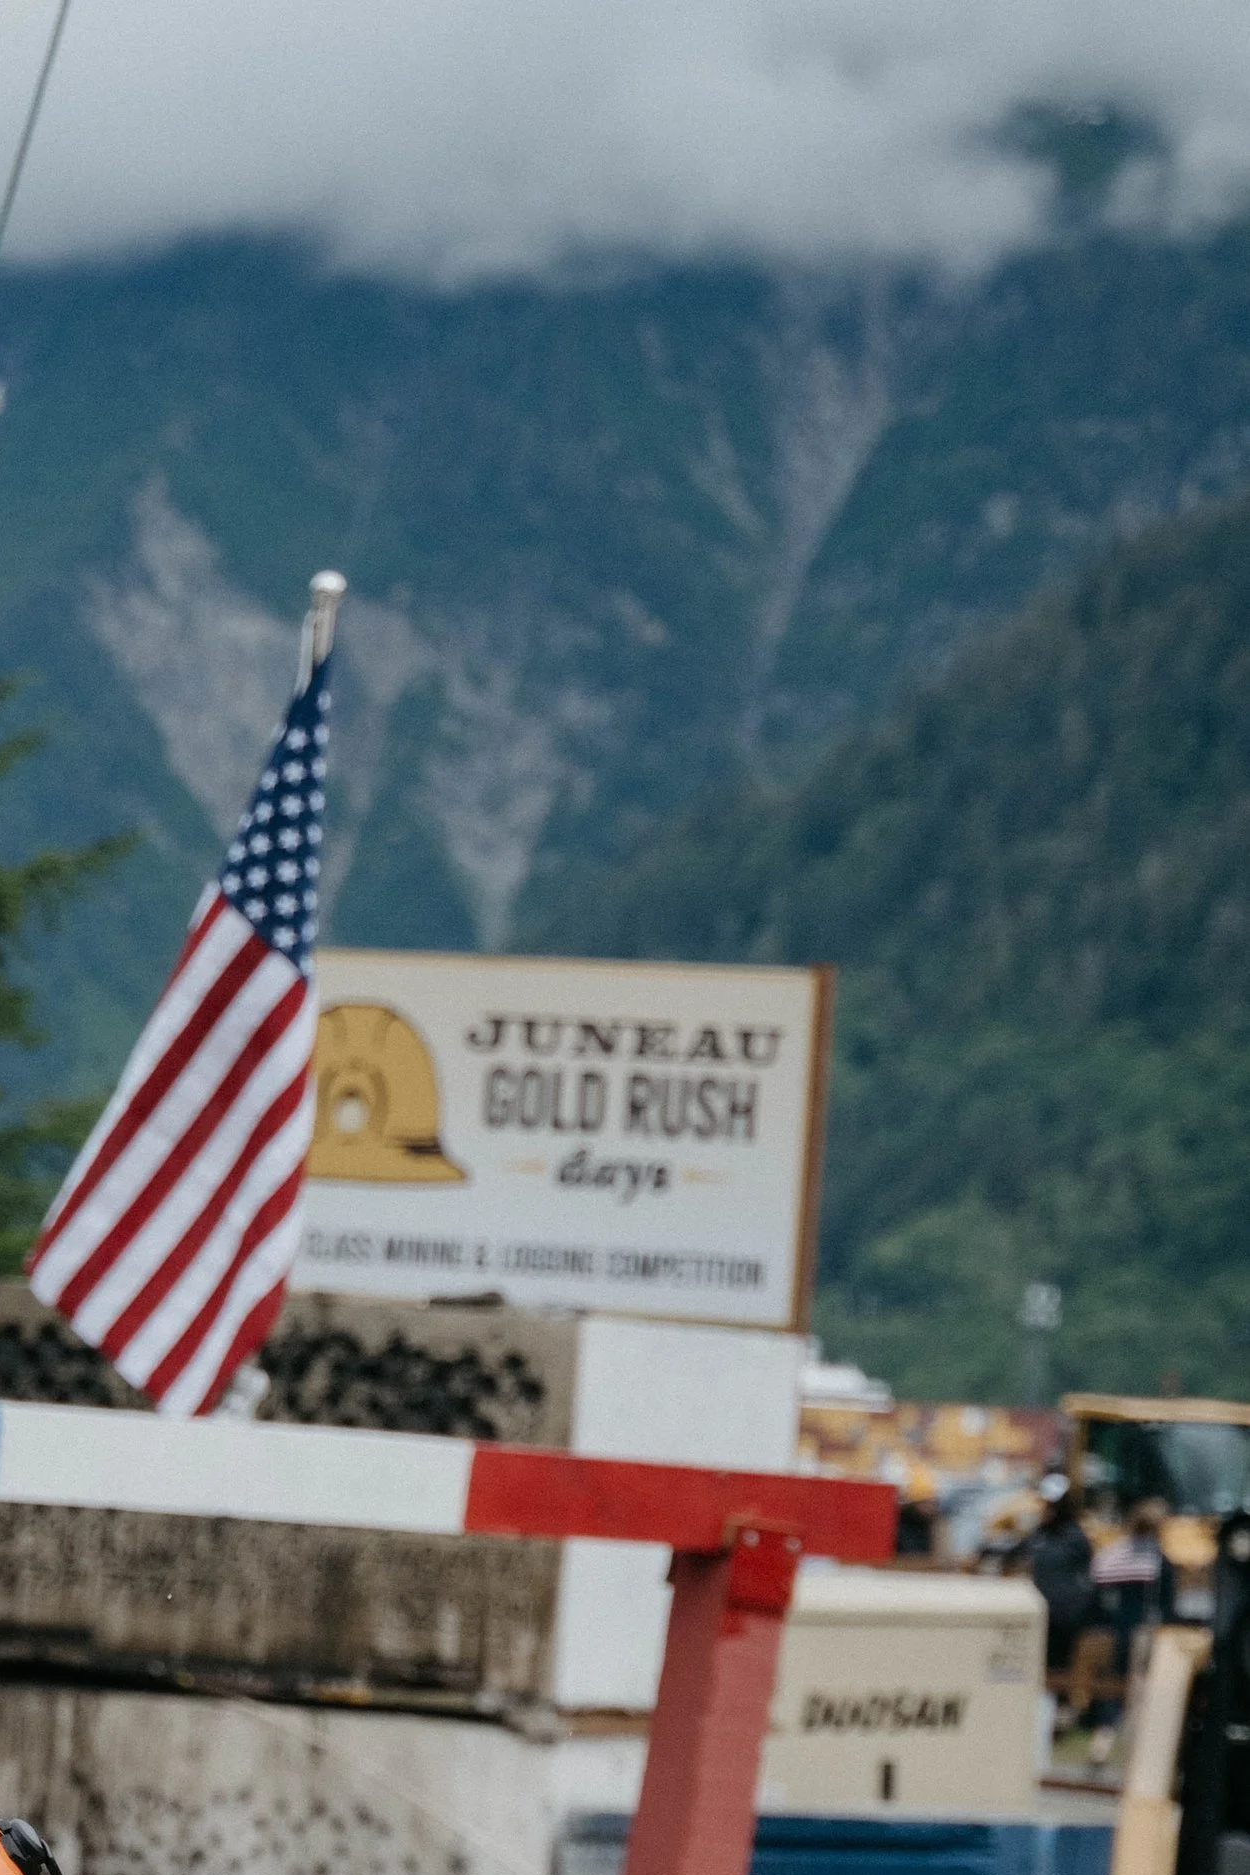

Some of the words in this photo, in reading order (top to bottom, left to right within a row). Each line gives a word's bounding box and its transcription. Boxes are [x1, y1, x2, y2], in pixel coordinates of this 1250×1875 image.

[466, 1012, 784, 1065] JUNEAU
[482, 1065, 608, 1133] GOLD
[624, 1072, 760, 1143] RUSH
[557, 1149, 671, 1202] days
